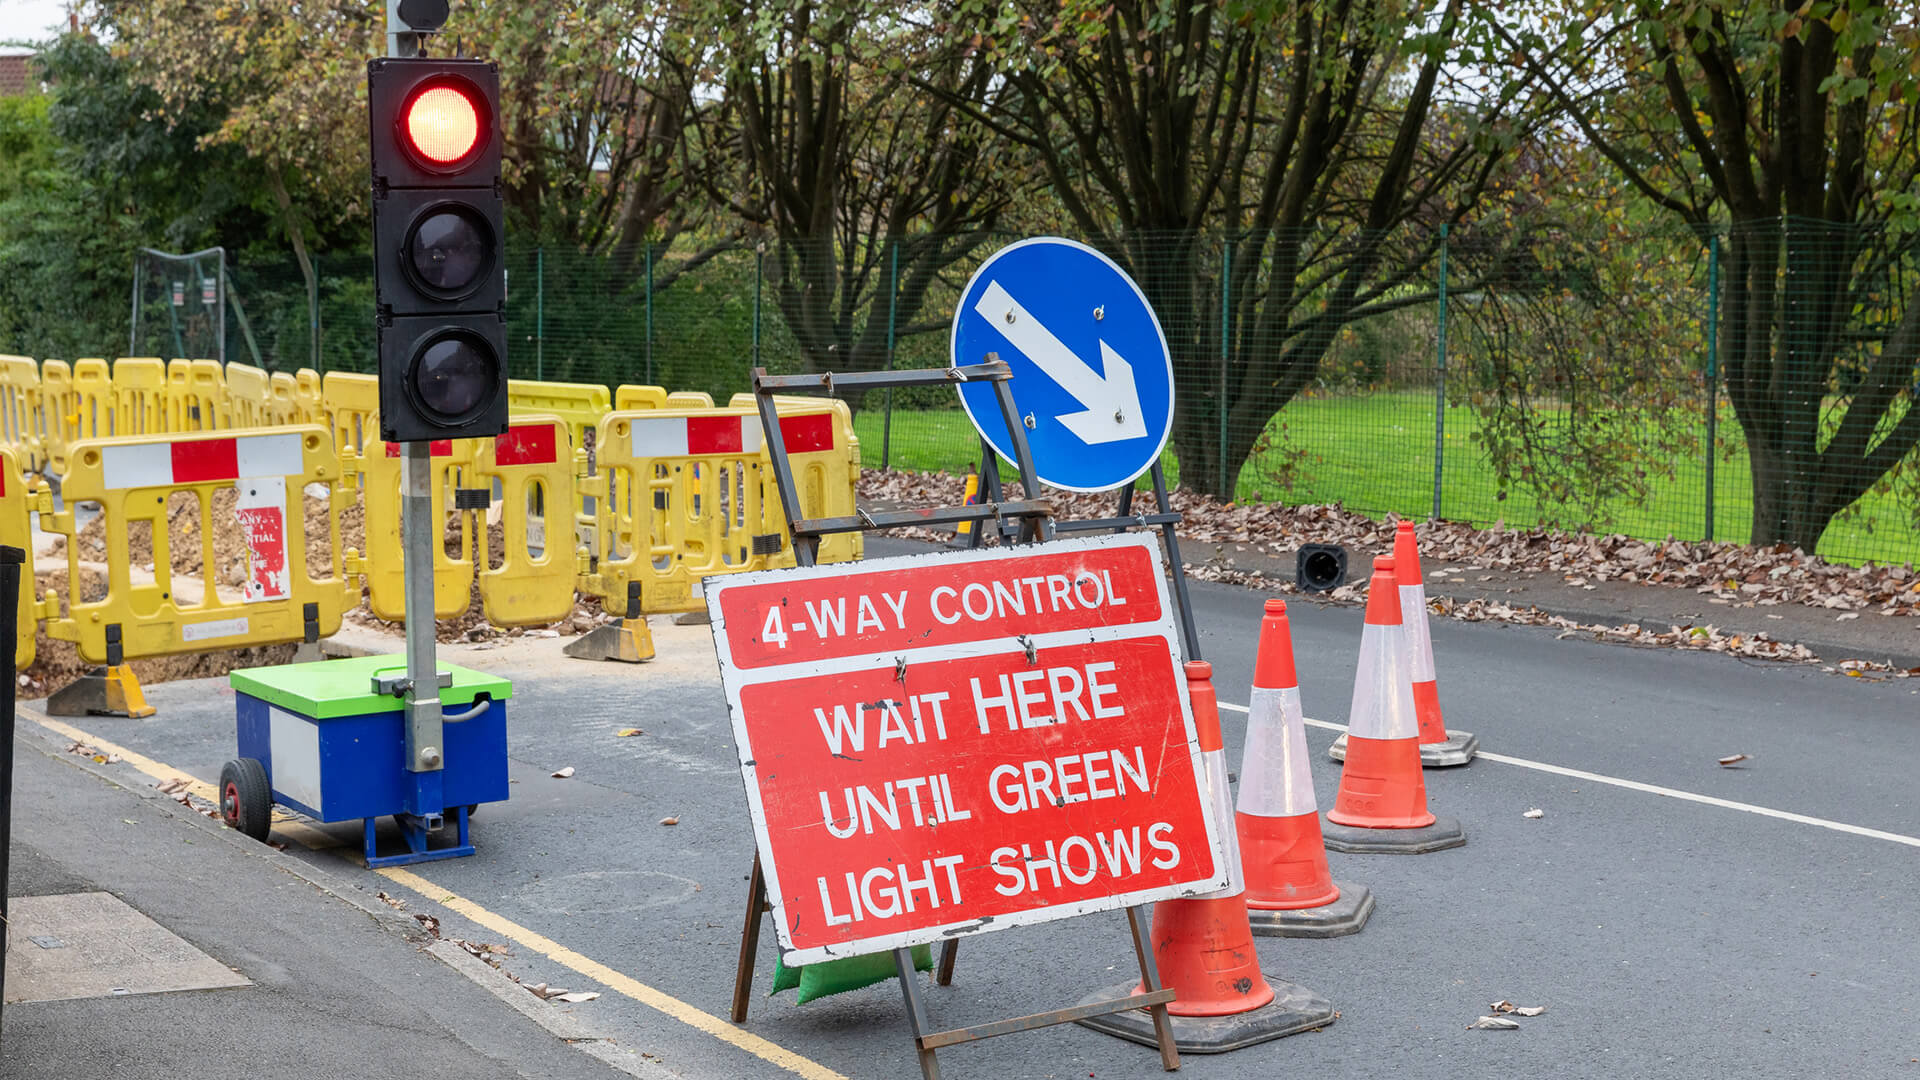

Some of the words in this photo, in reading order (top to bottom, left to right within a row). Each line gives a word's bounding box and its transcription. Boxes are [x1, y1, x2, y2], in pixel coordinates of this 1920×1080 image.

[762, 591, 908, 649] 4-WAY
[930, 570, 1127, 627] CONTROL
[814, 692, 951, 755] WAIT
[971, 662, 1125, 735] HERE
[819, 774, 971, 839] UNTIL
[989, 747, 1150, 814] GREEN
[817, 856, 964, 927] LIGHT
[992, 823, 1181, 897] SHOWS
